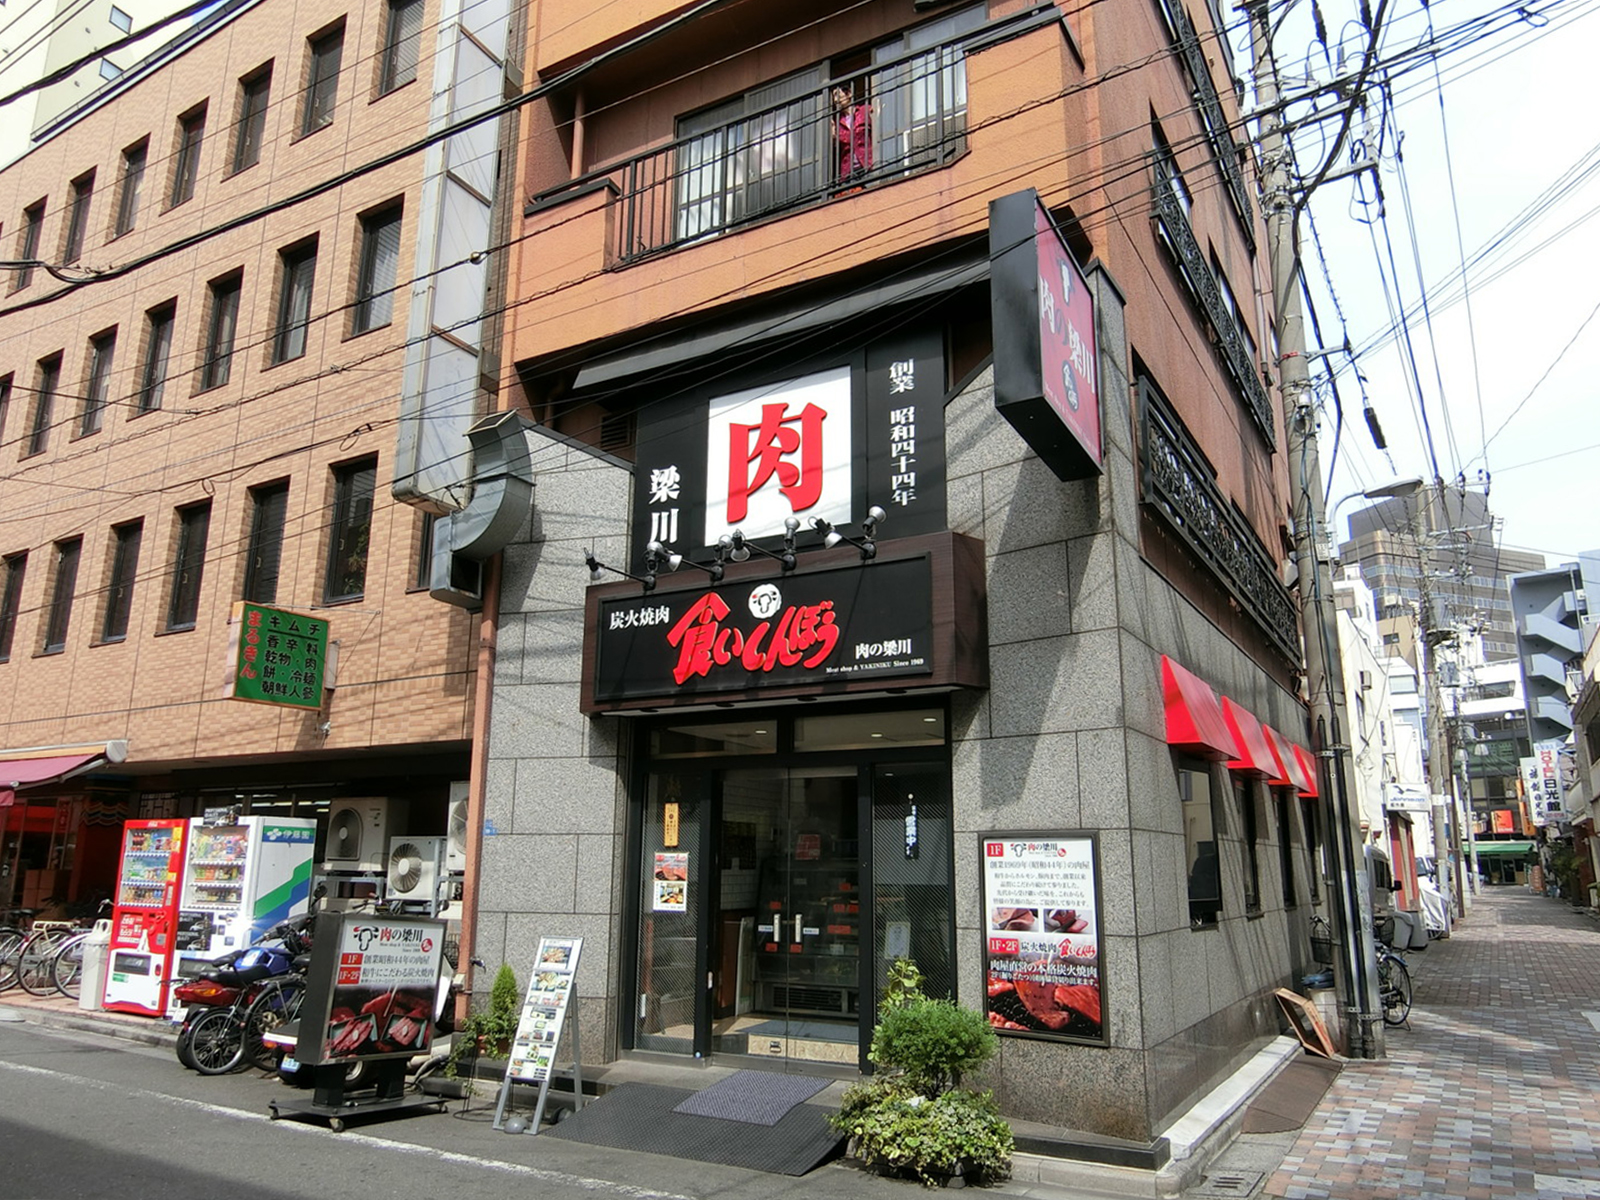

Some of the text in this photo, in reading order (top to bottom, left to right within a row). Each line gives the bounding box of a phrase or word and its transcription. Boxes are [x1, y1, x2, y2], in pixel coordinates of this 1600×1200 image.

[889, 358, 917, 506] 創業 昭和四十四年
[726, 402, 828, 524] 肉
[648, 465, 681, 544] 梁川
[269, 615, 320, 635] キムチ
[609, 605, 670, 630] 炭火焼肉
[239, 611, 262, 679] まるきん
[667, 591, 840, 685] 食いしんぼう
[855, 638, 912, 660] 肉の梁川
[990, 844, 1001, 855] 1F
[380, 926, 424, 942] 肉の梁川
[347, 954, 358, 964] 1F
